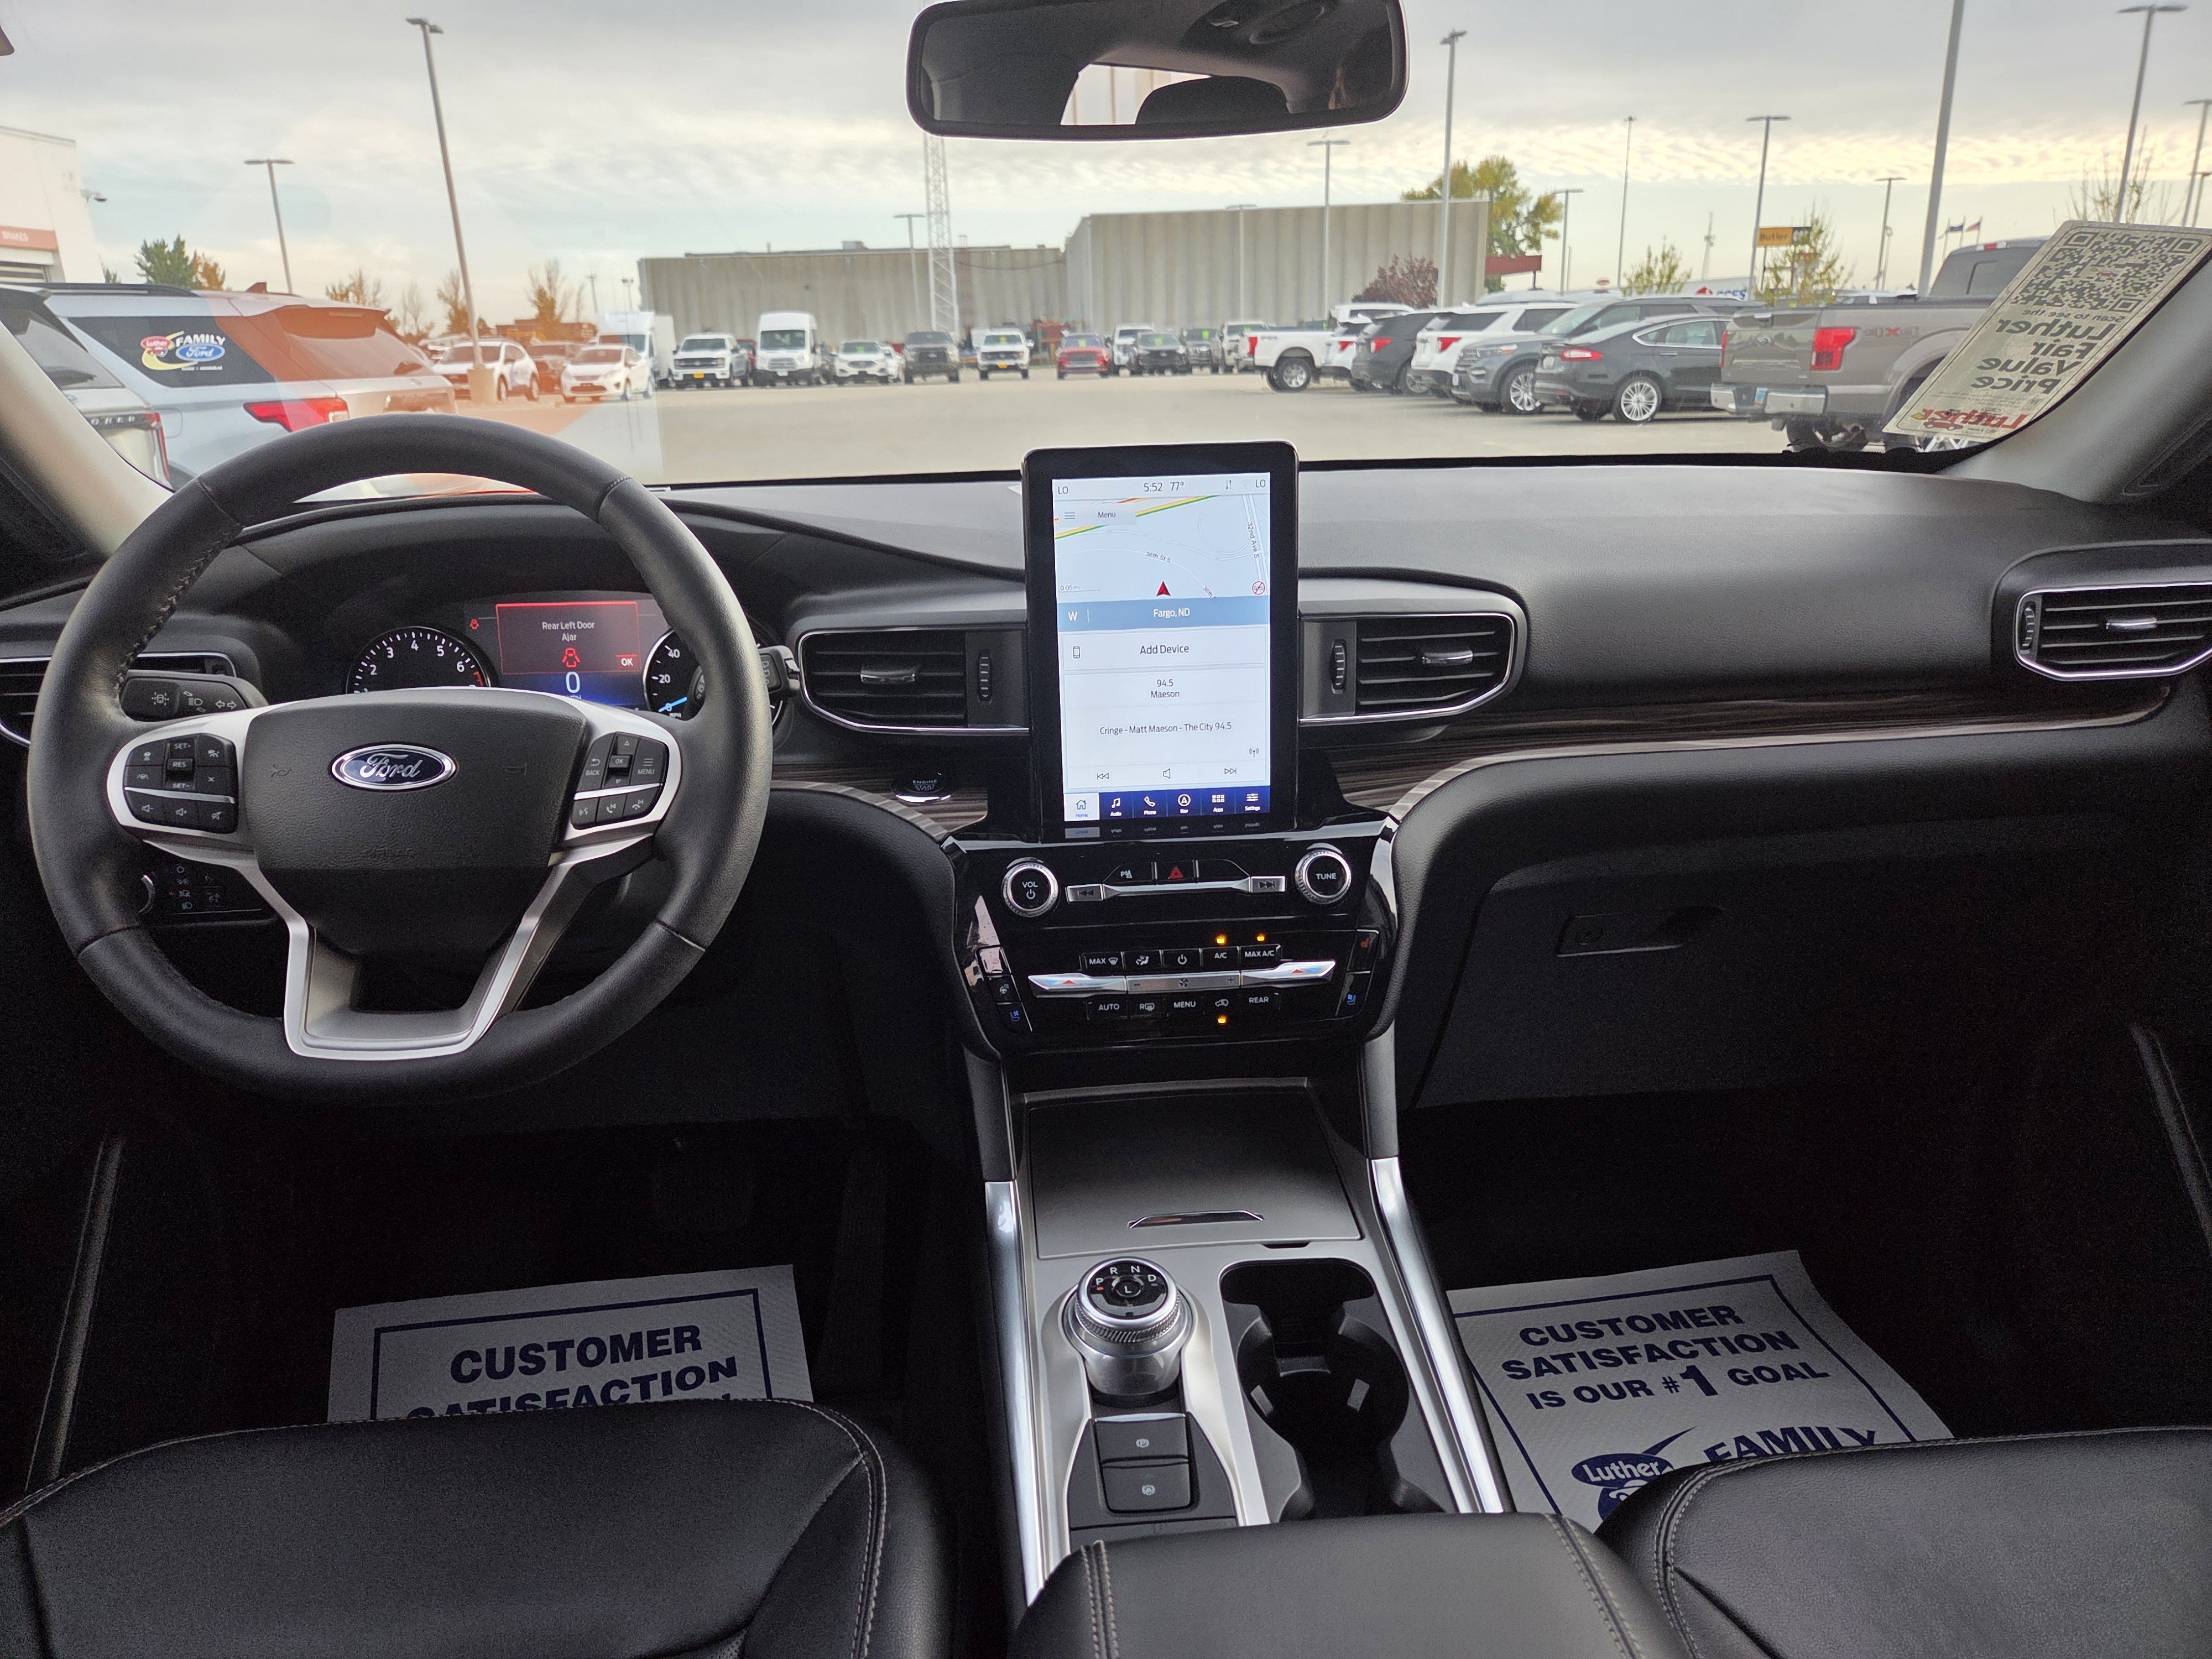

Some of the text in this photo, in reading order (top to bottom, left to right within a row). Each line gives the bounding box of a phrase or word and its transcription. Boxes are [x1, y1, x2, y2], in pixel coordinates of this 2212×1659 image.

[176, 334, 225, 347] FAMILY
[186, 346, 214, 357] Ford
[1144, 481, 1184, 492] 5:52 77°
[1255, 479, 1266, 488] LO
[1058, 486, 1068, 494] LO
[1247, 522, 1255, 539] 32nd
[1068, 612, 1077, 621] W
[1153, 608, 1190, 618] Fargo, ND
[542, 622, 559, 630] Rear
[562, 633, 577, 642] Ajar
[411, 639, 419, 651] 4
[437, 645, 444, 656] 5
[1140, 644, 1189, 655] Add Device
[387, 647, 394, 658] 3
[668, 649, 680, 658] 40
[370, 664, 377, 675] 2
[456, 661, 465, 672] 6
[566, 671, 580, 693] 0
[659, 674, 671, 683] 20
[1156, 679, 1173, 687] 94.5
[1150, 690, 1180, 698] Maeson
[1100, 726, 1123, 735] Cringe
[1129, 724, 1147, 733] Matt
[1149, 724, 1177, 732] Maeson
[1184, 723, 1198, 731] The
[1199, 722, 1213, 732] City
[1215, 722, 1232, 730] 94.5
[360, 753, 422, 779] Ford
[1130, 1265, 1140, 1274] N
[1519, 1305, 1745, 1346] CUSTOMER
[451, 1325, 702, 1383] CUSTOMER
[1501, 1330, 1801, 1380] SATISFACTION
[407, 1356, 737, 1417] SFACTION
[1526, 1361, 1830, 1410] IS OUR #1 GOAL
[1582, 1460, 1661, 1481] Luther
